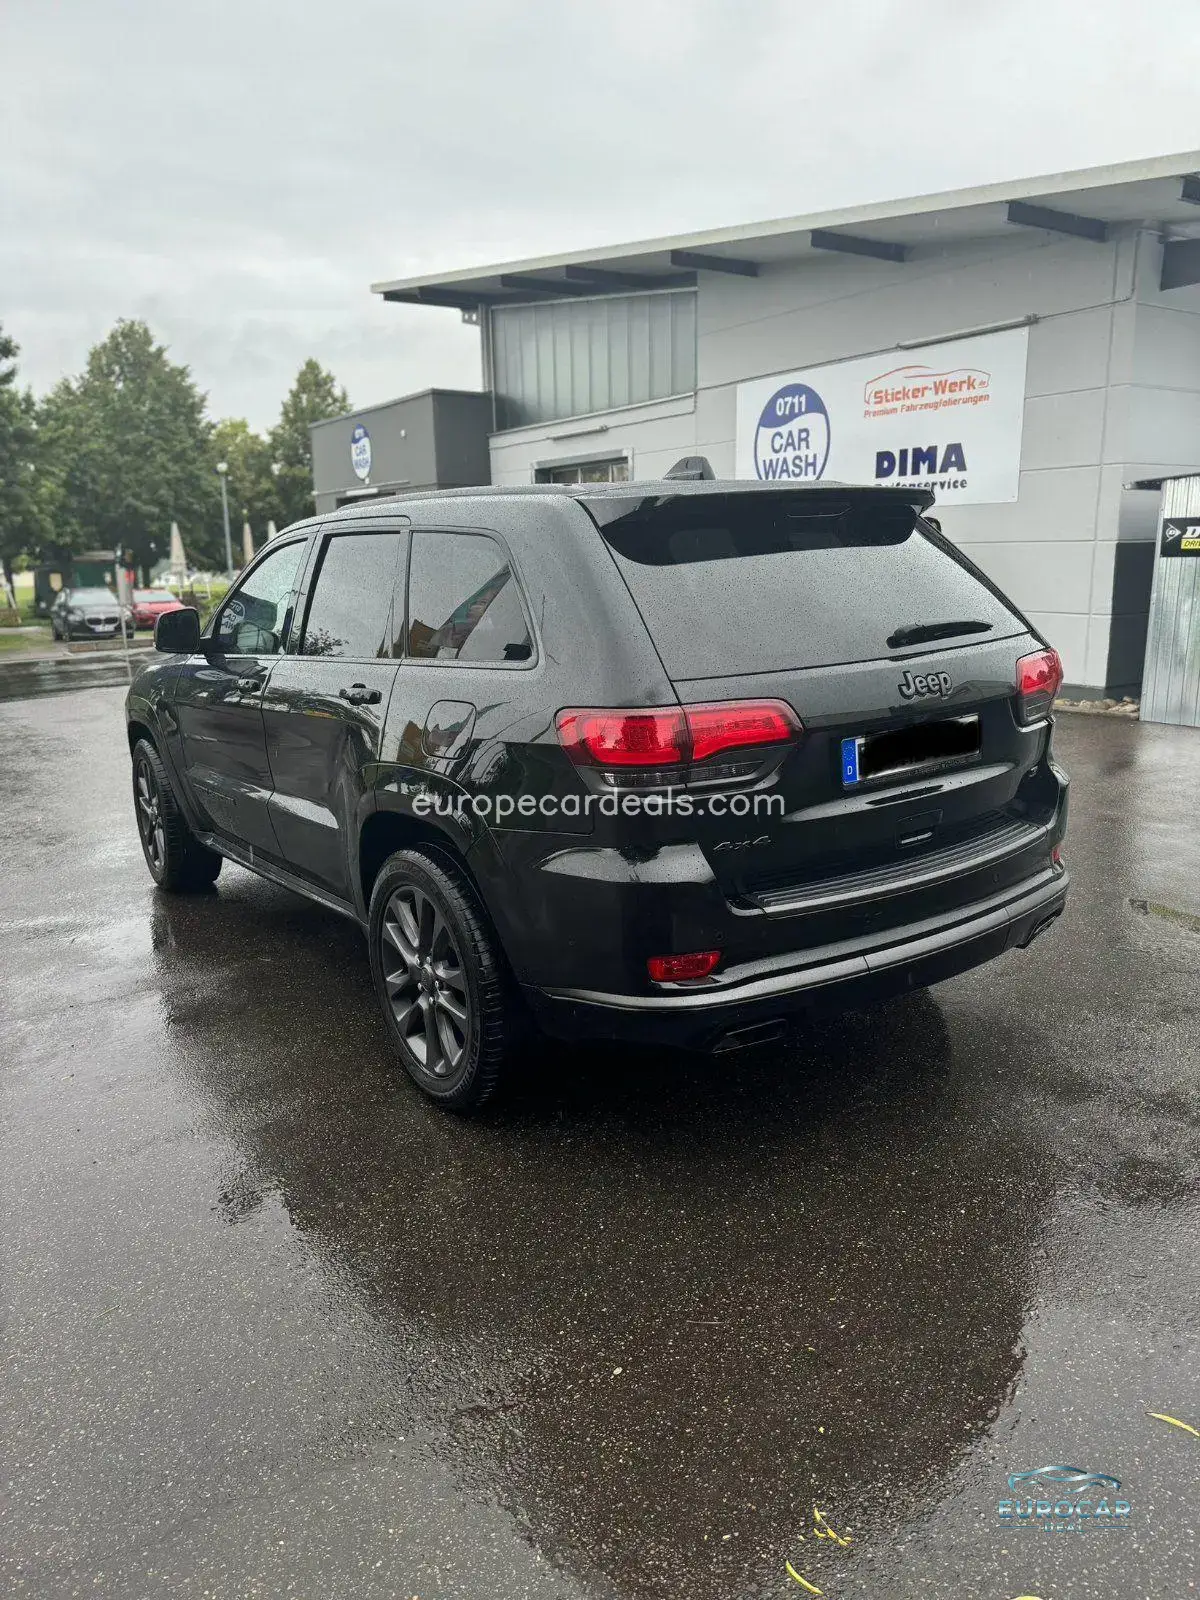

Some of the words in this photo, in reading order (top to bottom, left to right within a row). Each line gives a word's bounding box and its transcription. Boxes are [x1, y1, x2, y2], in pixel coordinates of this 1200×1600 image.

[776, 394, 806, 416] 0711
[864, 407, 898, 418] Premium
[900, 393, 990, 413] Fahrzeugfolierungen
[771, 427, 810, 453] CAR
[762, 453, 817, 480] WASH
[875, 443, 967, 479] DIMA
[898, 670, 952, 700] Jeep
[847, 765, 853, 775] D
